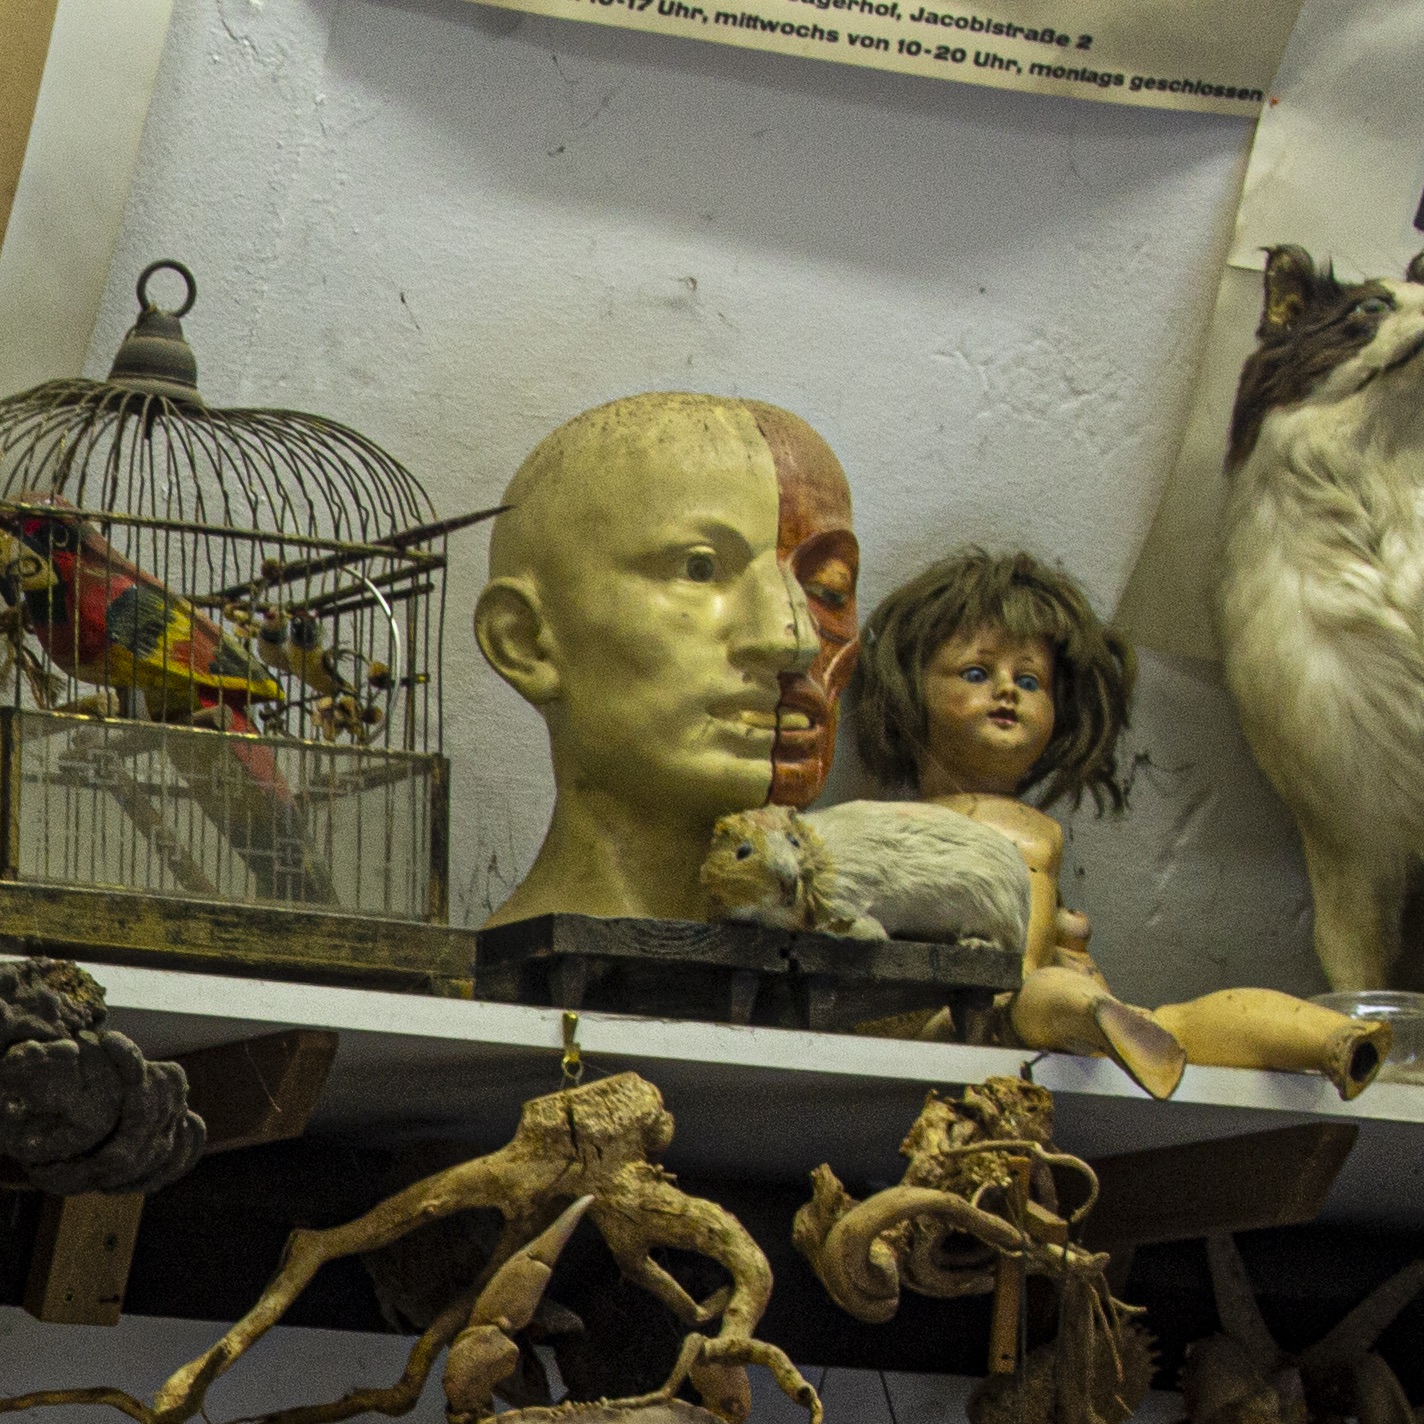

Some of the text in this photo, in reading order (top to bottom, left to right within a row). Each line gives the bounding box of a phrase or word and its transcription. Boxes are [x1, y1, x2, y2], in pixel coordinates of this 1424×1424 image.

[657, 1, 709, 24] Uhr,
[714, 10, 839, 44] mittwochs
[847, 31, 890, 52] von
[897, 38, 968, 64] 10-20
[973, 49, 1023, 75] Uhr,
[1028, 60, 1125, 88] montags
[1129, 75, 1265, 103] geschlossen
[909, 7, 1071, 48] Jacobistraße
[1076, 34, 1094, 51] 2
